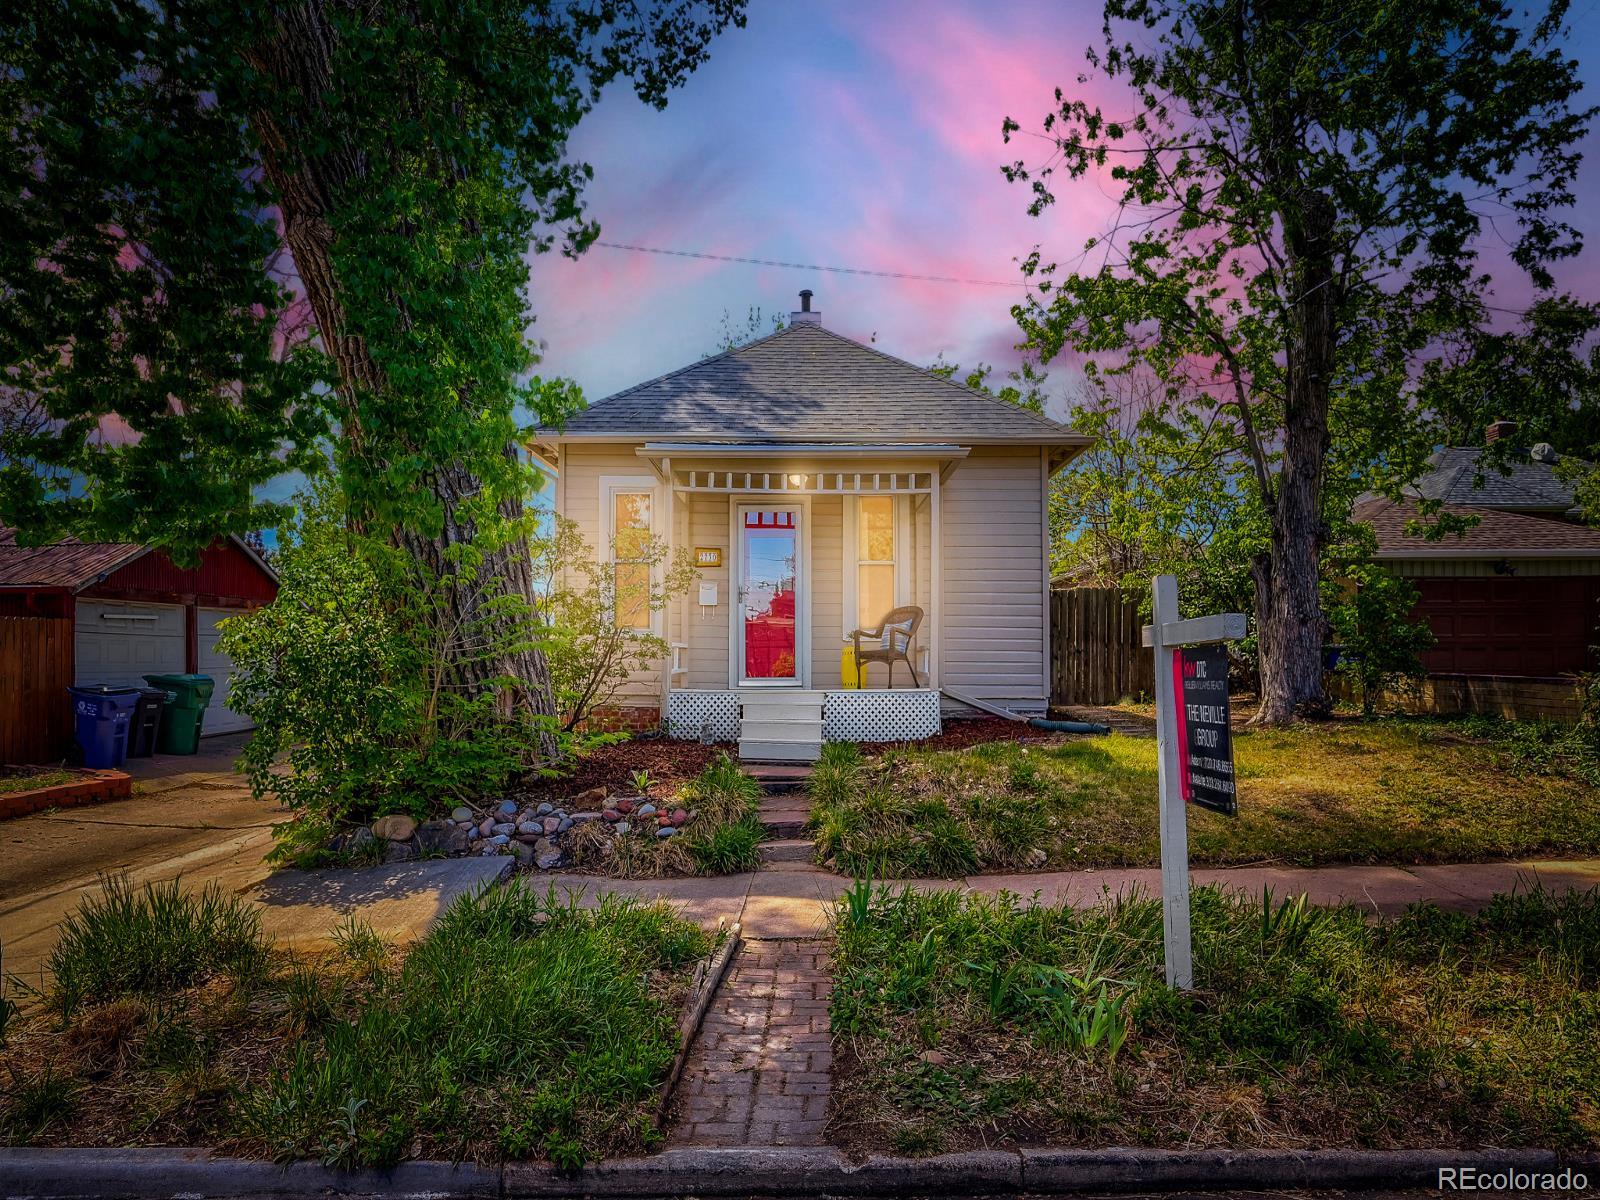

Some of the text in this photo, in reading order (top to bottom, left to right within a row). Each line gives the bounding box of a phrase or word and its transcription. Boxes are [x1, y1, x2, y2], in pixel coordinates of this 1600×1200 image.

[1196, 660, 1207, 678] DTC
[1187, 704, 1226, 724] THE NEVILLE
[1195, 728, 1219, 748] GROUP
